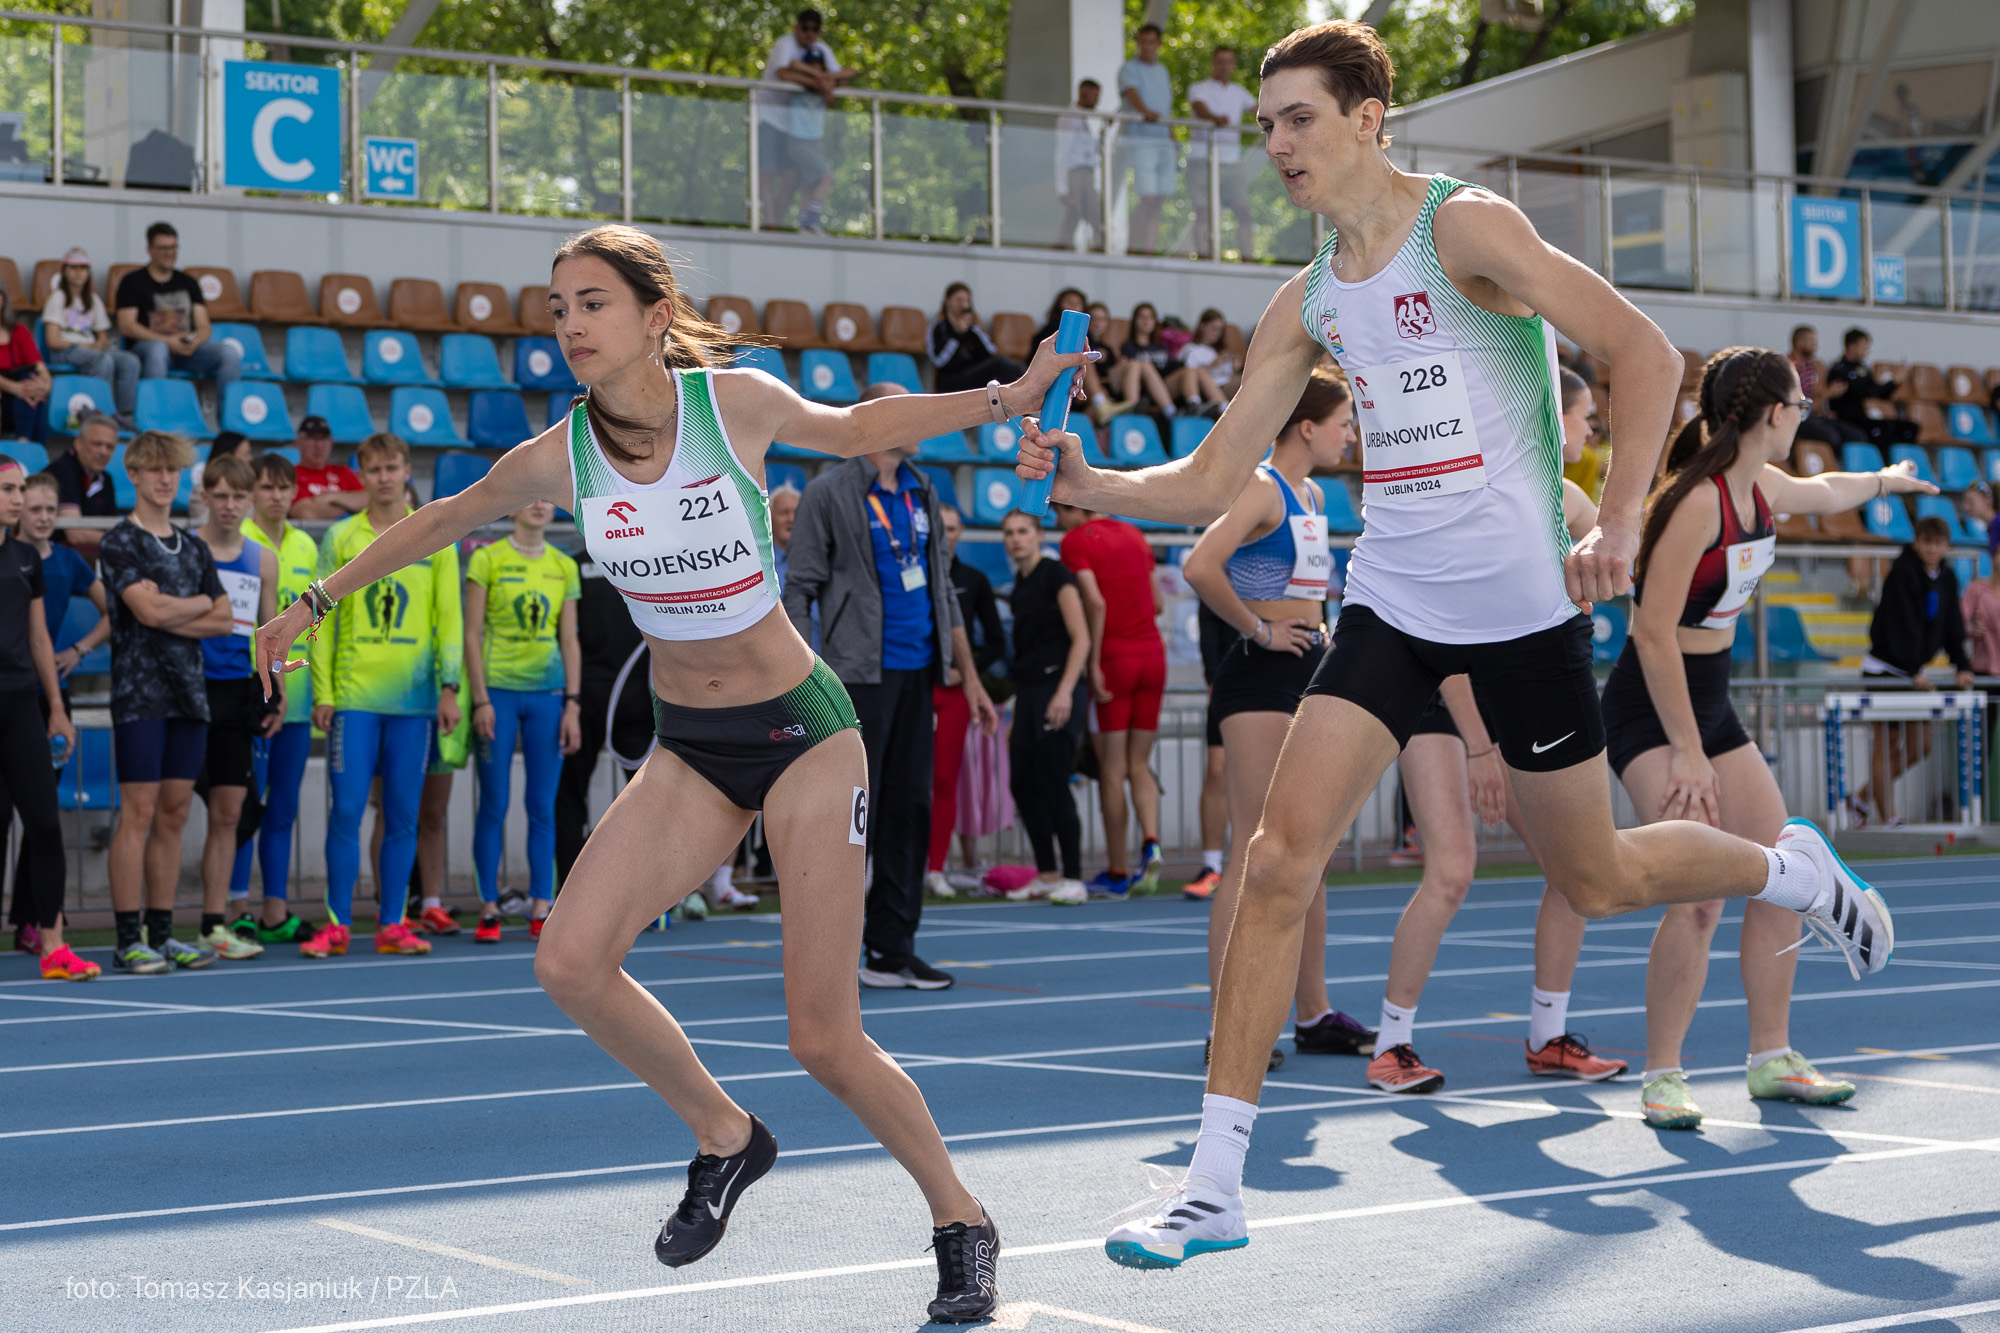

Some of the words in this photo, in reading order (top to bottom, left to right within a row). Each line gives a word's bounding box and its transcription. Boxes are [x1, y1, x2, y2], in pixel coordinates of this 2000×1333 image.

[245, 70, 320, 95] SEKTOR
[252, 97, 315, 183] C
[370, 145, 413, 175] WC
[1805, 222, 1848, 289] D
[1877, 261, 1904, 282] WC
[1399, 364, 1448, 394] 228
[1365, 418, 1464, 448] URBANOWICZ
[1412, 466, 1441, 475] SZTAFETACH
[1441, 458, 1480, 471] MIESZANYCH
[1384, 483, 1414, 496] LUBLIN
[1415, 480, 1442, 492] 2024
[679, 490, 730, 521] 221
[605, 526, 645, 540] ORLEN
[602, 539, 752, 578] WOJEŃSKA
[690, 590, 726, 599] SZTAFETACH
[726, 576, 761, 594] MIESZANYCH
[654, 605, 694, 614] LUBLIN
[695, 602, 726, 614] 2024
[854, 789, 866, 836] 6
